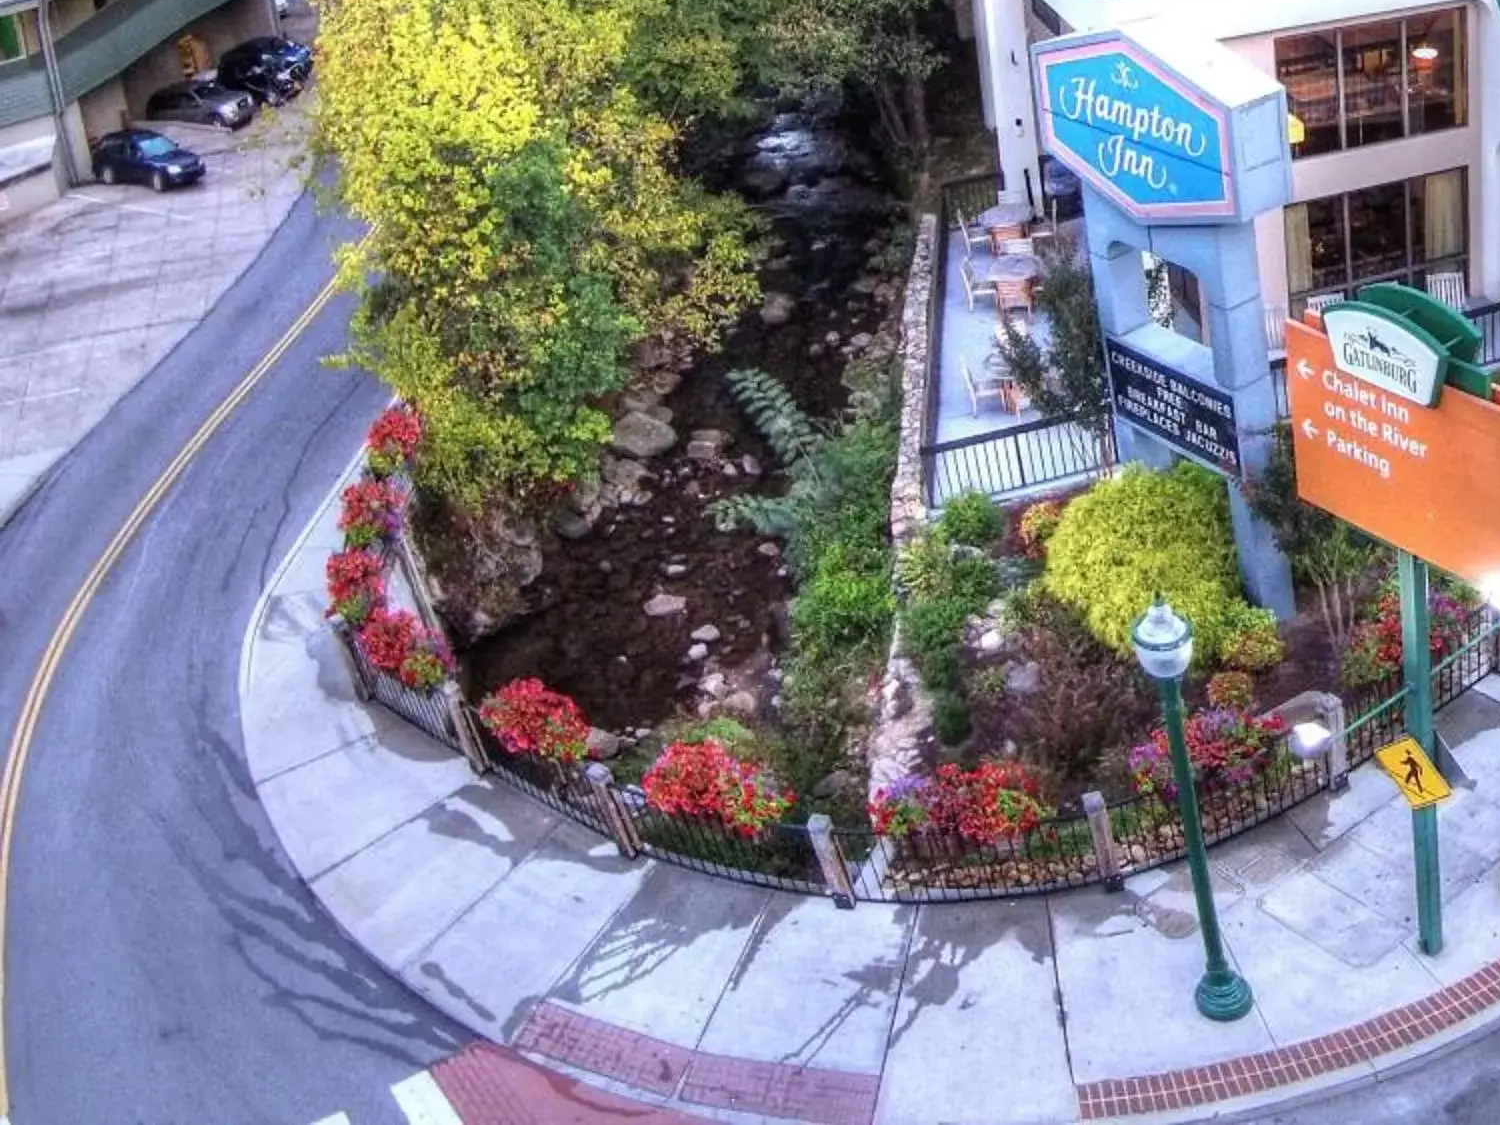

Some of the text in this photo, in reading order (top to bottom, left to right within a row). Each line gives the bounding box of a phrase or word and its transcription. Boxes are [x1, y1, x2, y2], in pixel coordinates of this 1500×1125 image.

[1060, 77, 1206, 157] Hampton
[1098, 134, 1167, 189] Inn
[1111, 351, 1232, 420] CREEKSIDE BALCONIES
[1321, 368, 1410, 424] Chalet Inn
[1343, 342, 1417, 394] GATLINBURG
[1127, 385, 1217, 441] BREAKFAST BAR
[1157, 385, 1183, 409] FREE
[1118, 394, 1237, 465] FIREPLACES JACUZZIS
[1323, 401, 1429, 458] on the River
[1326, 429, 1391, 479] Parking
